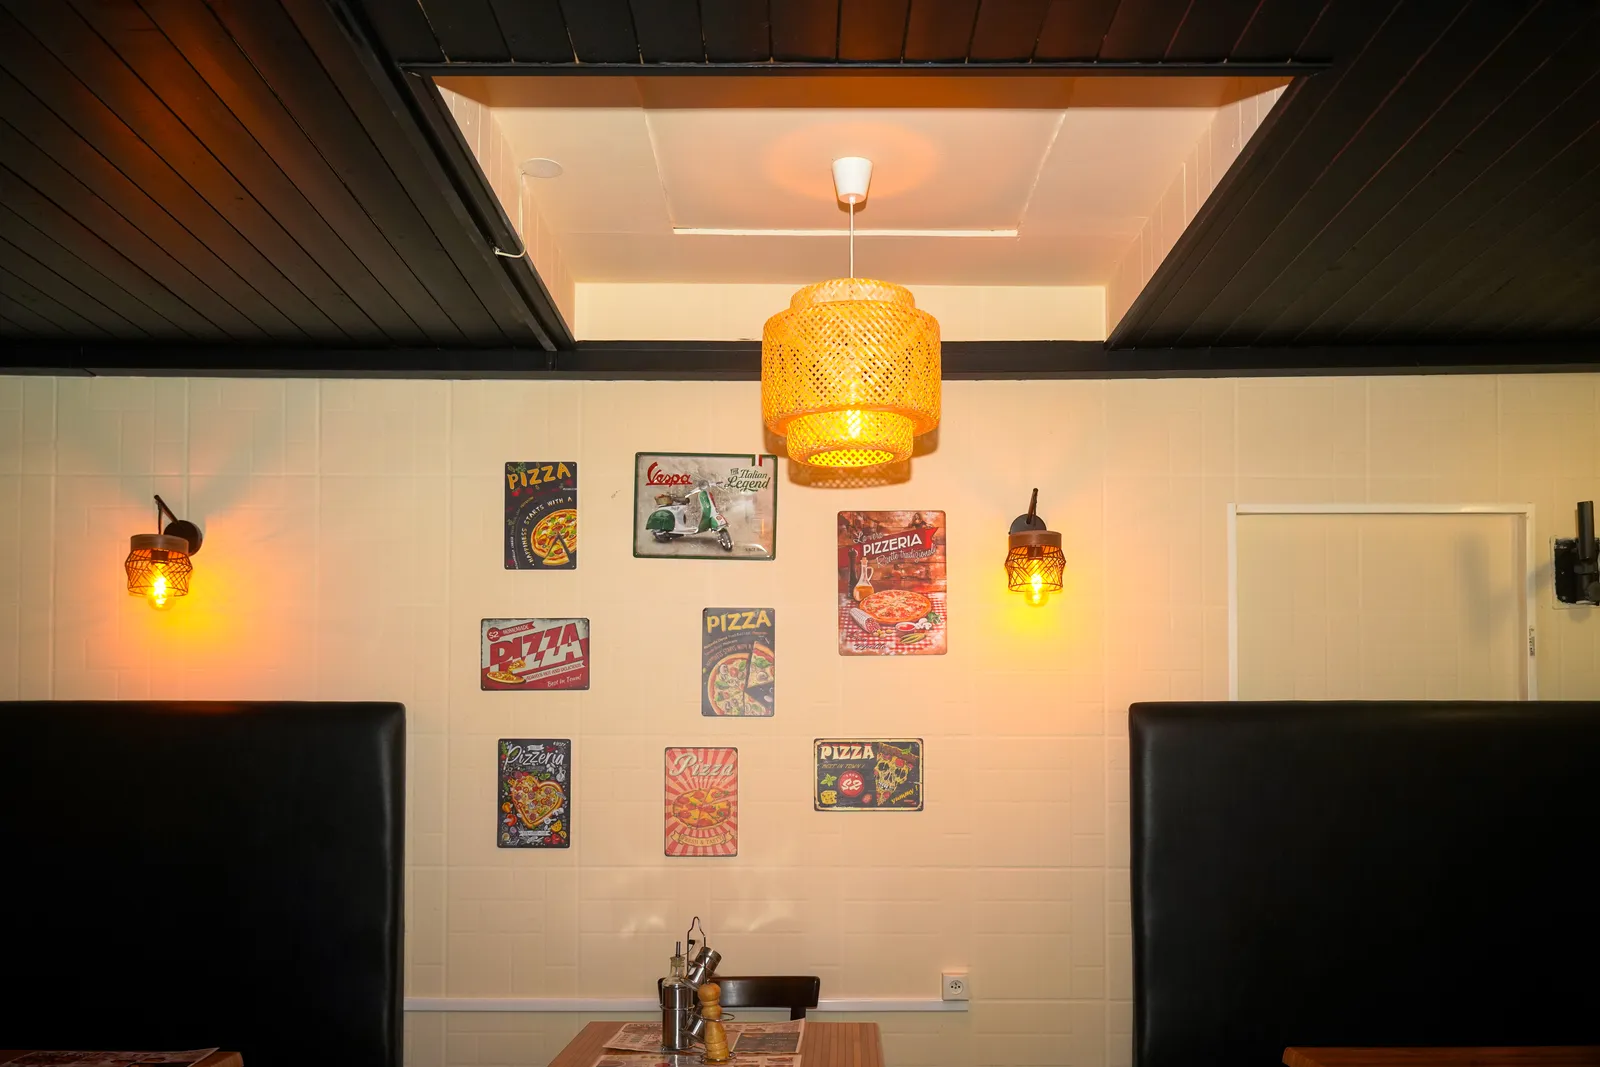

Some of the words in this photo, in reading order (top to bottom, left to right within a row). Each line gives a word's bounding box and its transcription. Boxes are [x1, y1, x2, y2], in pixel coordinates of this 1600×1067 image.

[507, 462, 571, 490] PIZZA
[645, 461, 693, 487] Vespa
[724, 476, 771, 492] Legend
[730, 467, 739, 475] THE
[739, 468, 768, 479] Italian
[547, 498, 564, 507] WITH
[863, 533, 923, 557] PIZZERIA
[706, 610, 772, 633] PIZZA
[489, 622, 584, 675] PIZZA
[503, 744, 565, 770] Pizzeria
[820, 744, 875, 760] PIZZA
[669, 752, 735, 777] Pizza
